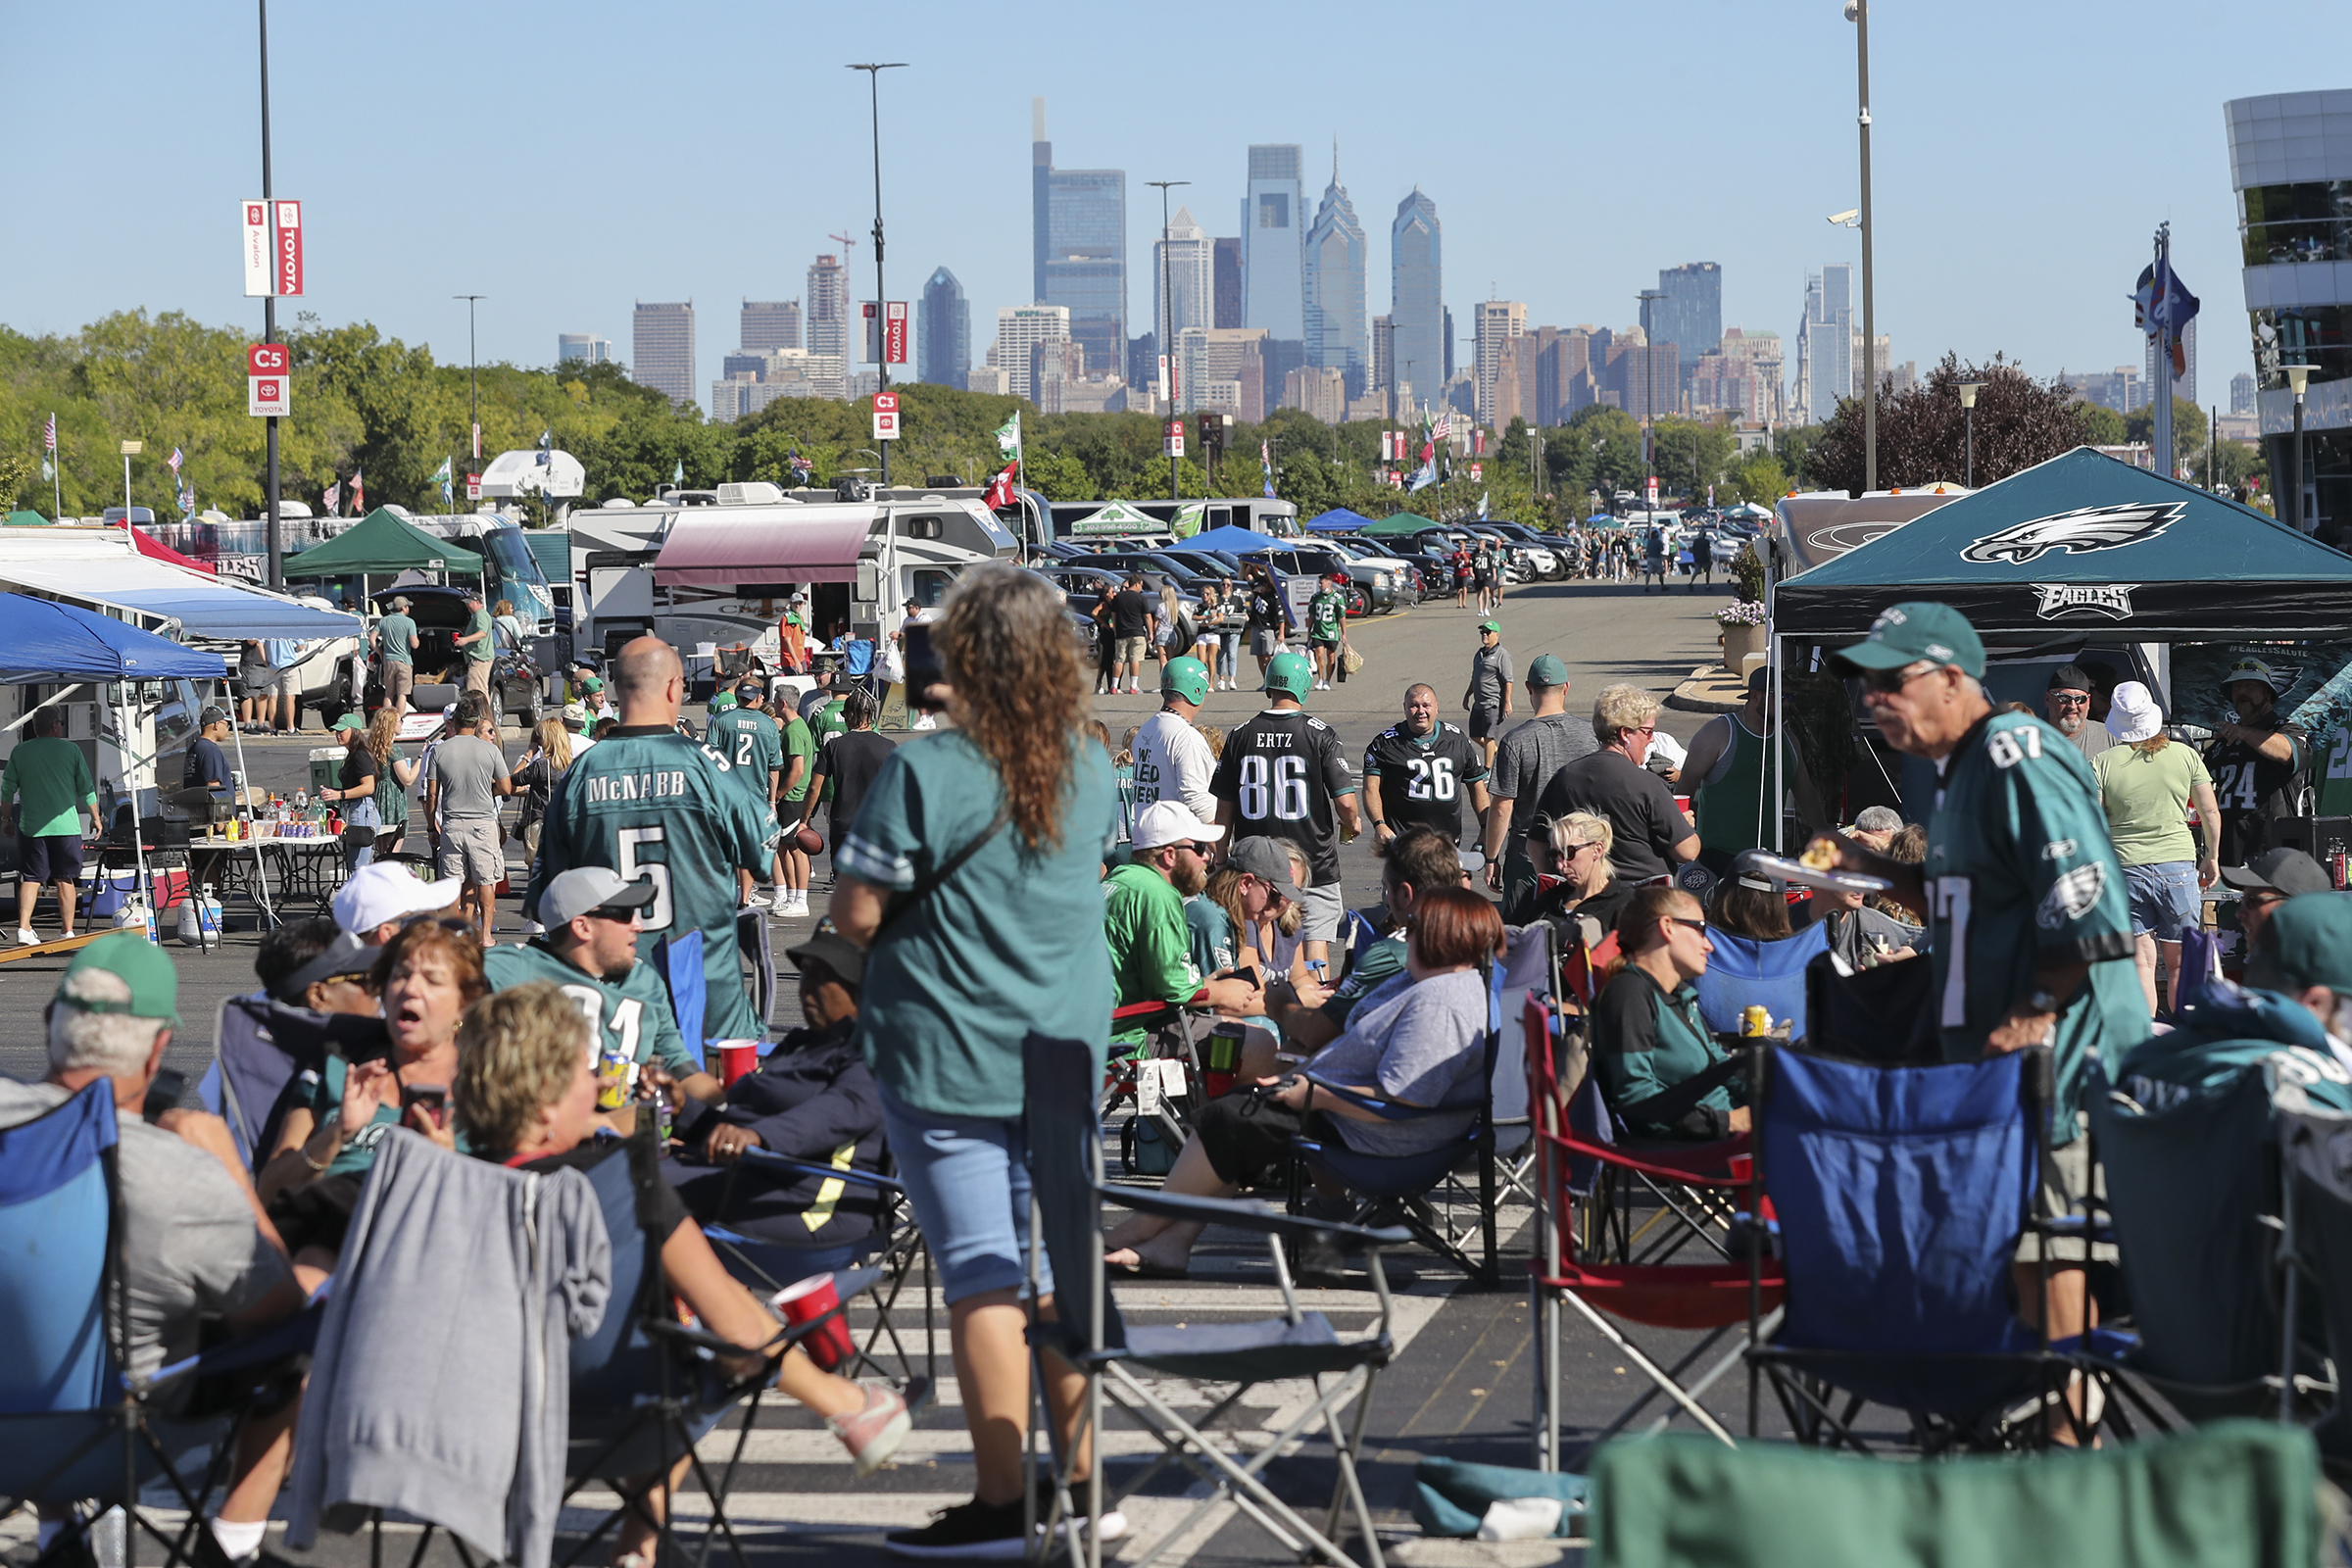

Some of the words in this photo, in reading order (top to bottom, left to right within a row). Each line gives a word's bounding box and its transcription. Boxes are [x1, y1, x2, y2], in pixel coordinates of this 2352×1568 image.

[252, 229, 261, 269] Avalon
[284, 228, 297, 294] TOYOTA
[1703, 263, 1713, 271] W
[892, 319, 902, 363] TOYOTA
[254, 349, 282, 368] C5
[876, 395, 895, 409] C3
[1475, 557, 1488, 569] 20
[1315, 602, 1335, 622] 92
[2038, 584, 2132, 614] EAGLES
[737, 719, 759, 731] HURTS
[1255, 732, 1294, 749] ERTZ
[700, 743, 732, 773] 5
[736, 733, 755, 767] 2
[1988, 724, 2042, 769] 87
[587, 769, 686, 804] McNABB
[1239, 755, 1311, 822] 86
[1406, 757, 1456, 801] 26
[2219, 760, 2258, 810] 24
[617, 826, 674, 932] 5
